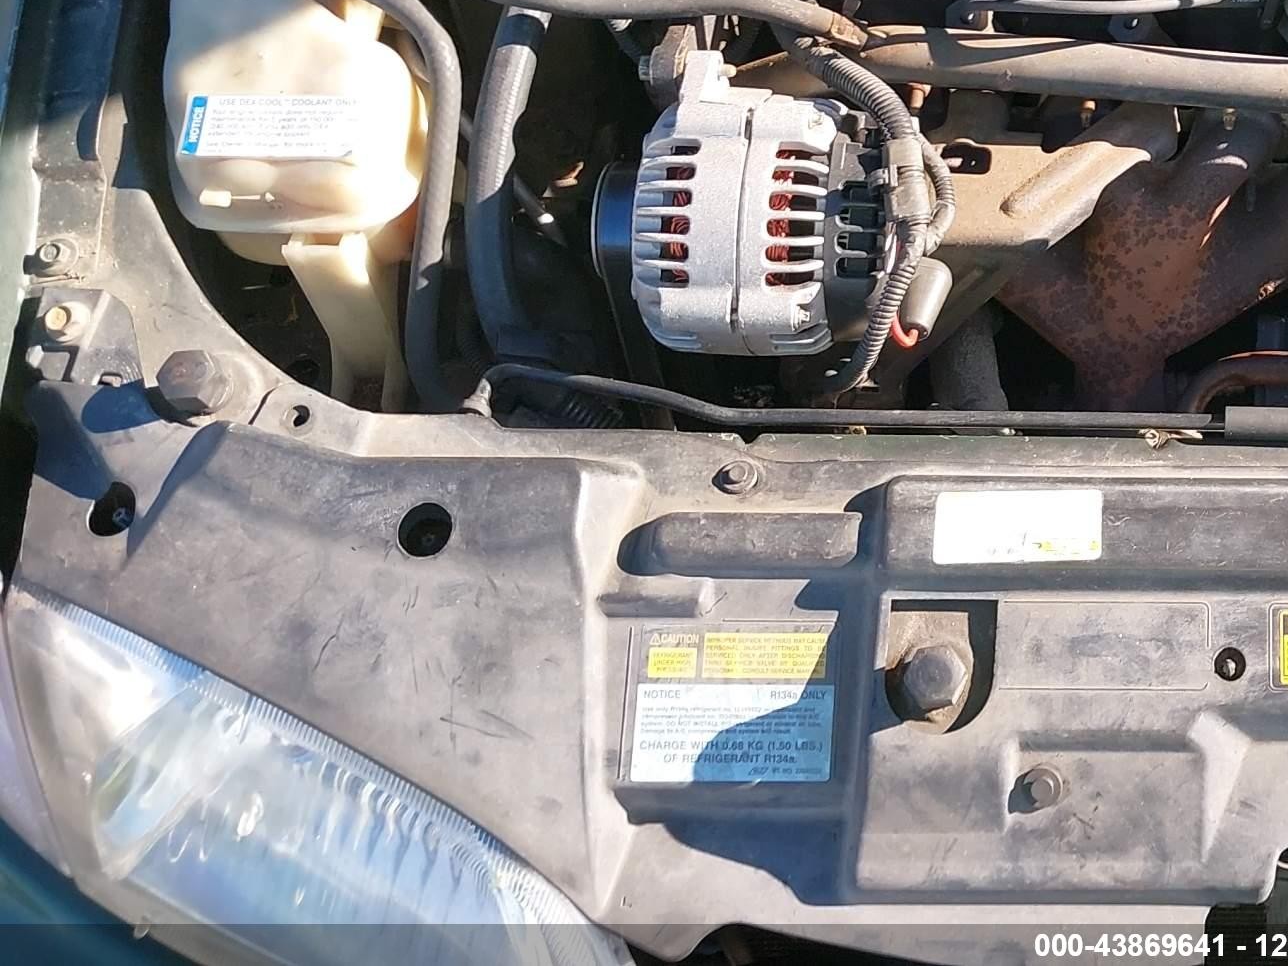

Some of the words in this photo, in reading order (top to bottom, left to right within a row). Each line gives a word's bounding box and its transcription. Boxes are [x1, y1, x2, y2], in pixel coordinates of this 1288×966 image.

[219, 98, 236, 106] USE
[291, 98, 333, 106] COOLANT
[188, 107, 205, 143] NOTICE
[660, 634, 700, 644] CAUTION
[643, 690, 681, 699] NOTICE
[770, 690, 798, 700] R134a
[801, 690, 827, 700] ONLY
[639, 740, 688, 751] CHARGE
[690, 740, 718, 751] WITH
[748, 740, 764, 751] KG
[663, 754, 678, 764] OF
[682, 754, 761, 764] REFRIGERANT
